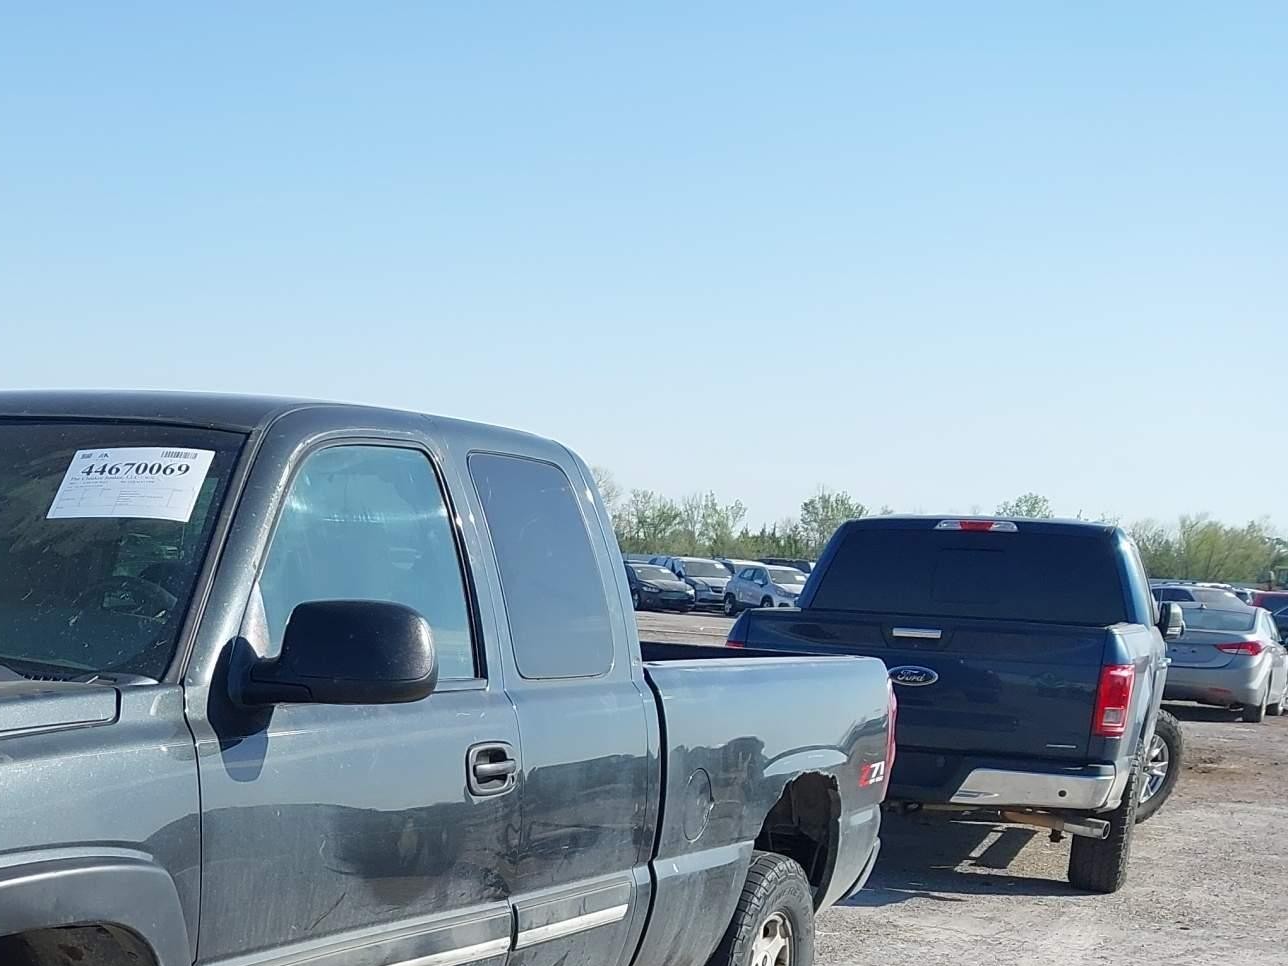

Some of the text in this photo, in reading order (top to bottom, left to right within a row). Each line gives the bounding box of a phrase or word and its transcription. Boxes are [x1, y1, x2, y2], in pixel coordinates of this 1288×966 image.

[81, 462, 190, 477] 44670069
[897, 670, 926, 681] Ford
[859, 761, 885, 787] Z71
